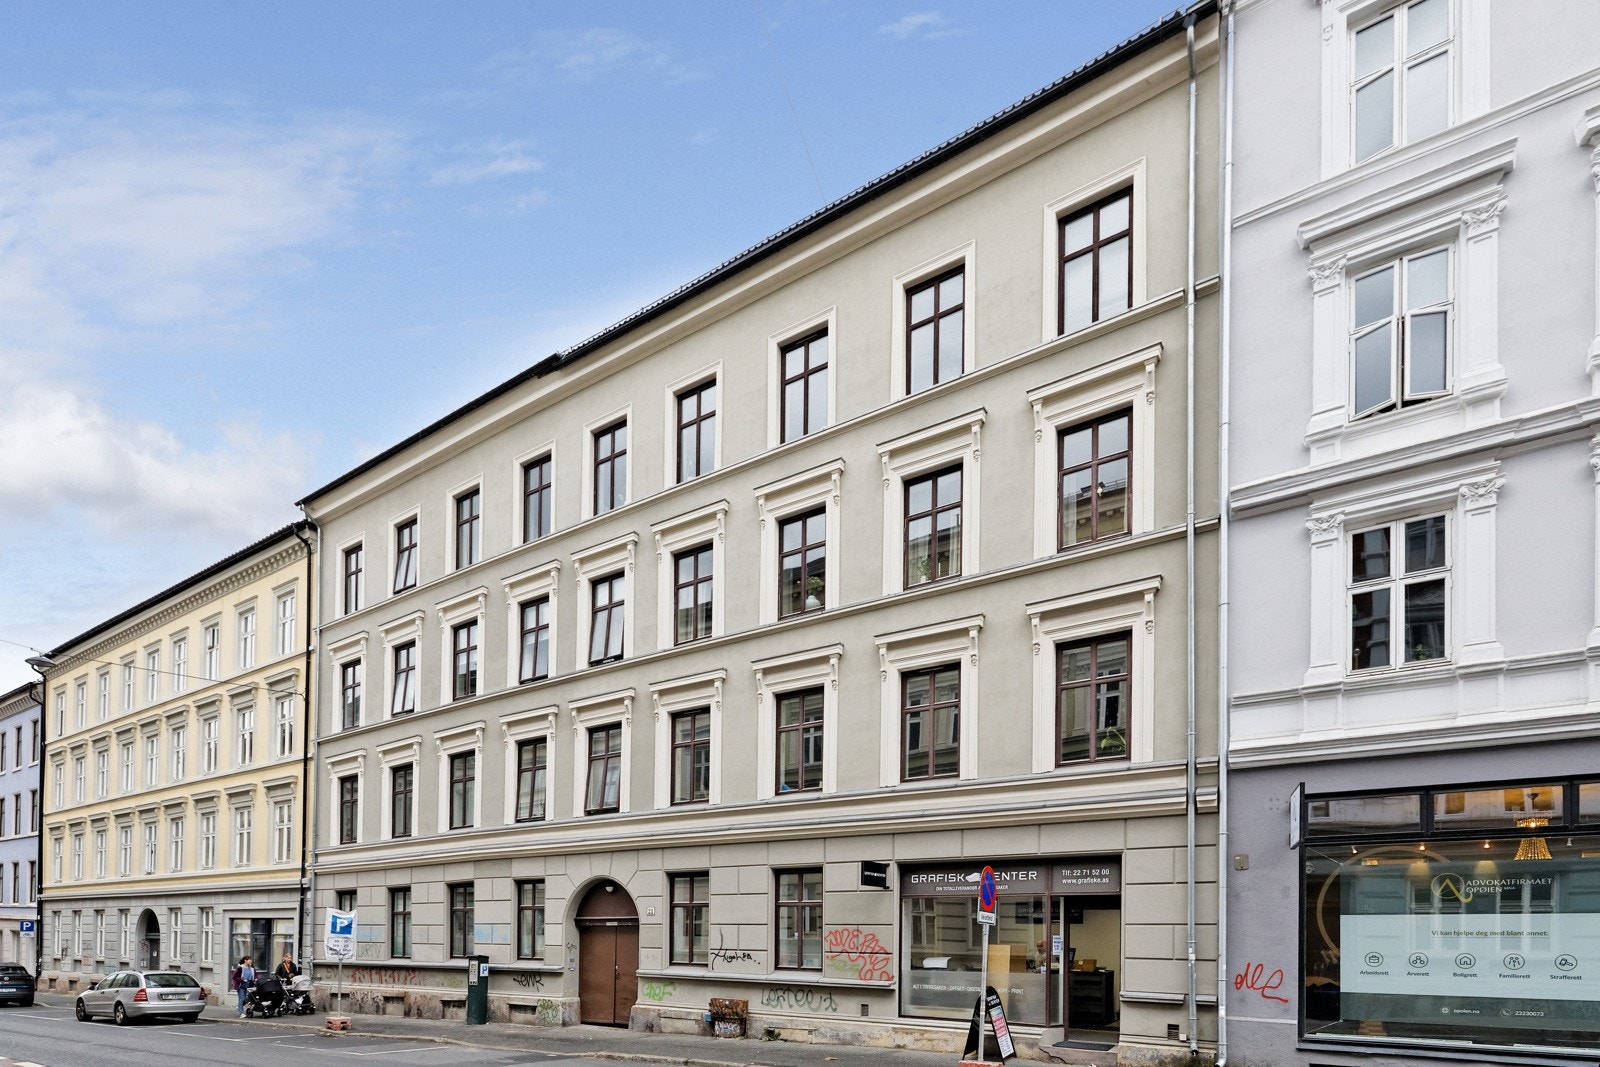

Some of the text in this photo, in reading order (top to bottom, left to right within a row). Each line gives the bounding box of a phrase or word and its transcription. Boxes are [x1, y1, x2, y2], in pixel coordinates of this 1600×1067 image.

[911, 871, 1038, 884] GRAFISK ENTER
[1466, 878, 1552, 887] ADVOKATFIRMAET
[23, 921, 32, 931] P
[336, 918, 349, 933] P
